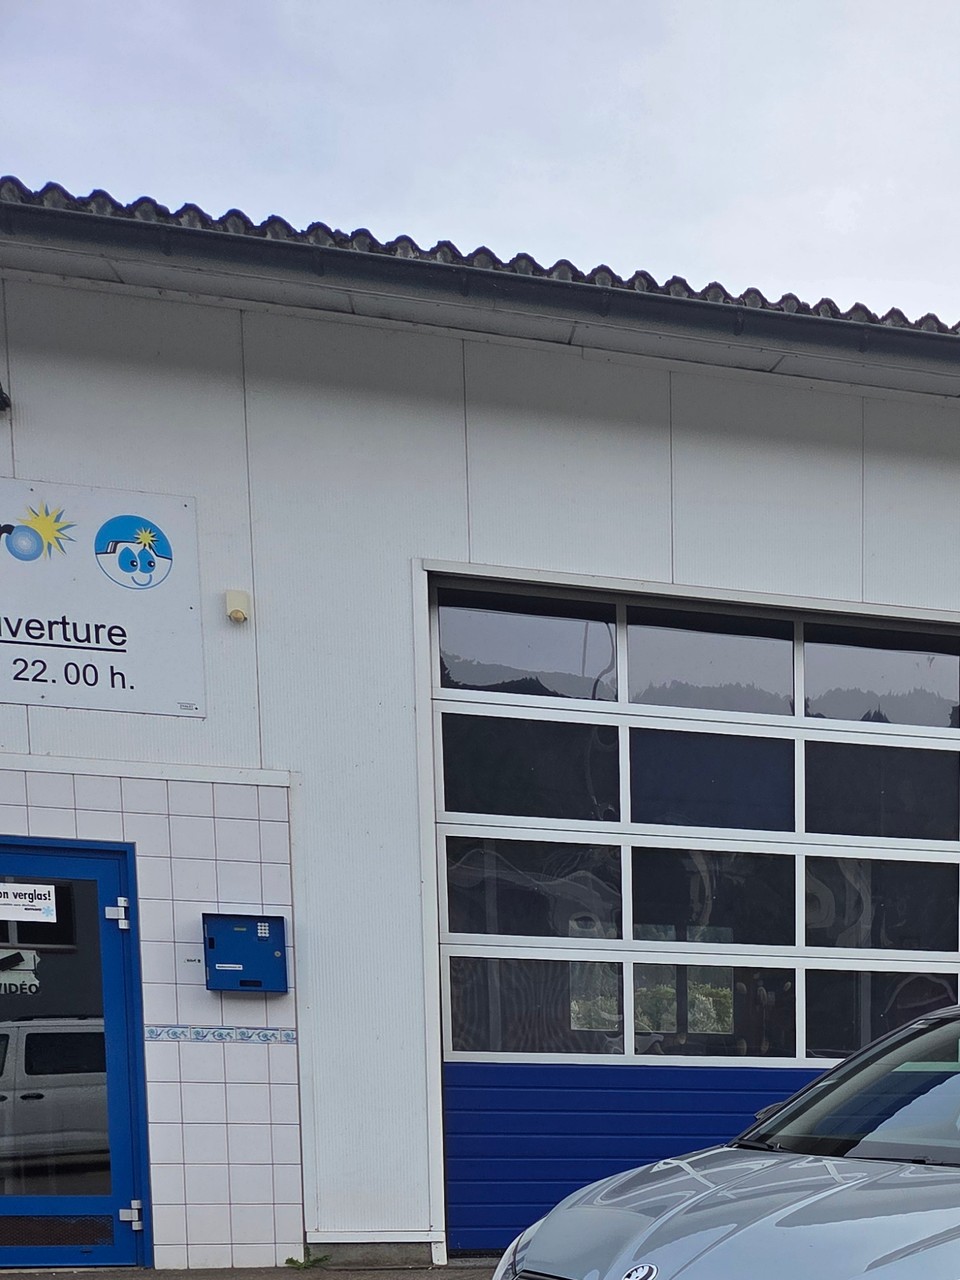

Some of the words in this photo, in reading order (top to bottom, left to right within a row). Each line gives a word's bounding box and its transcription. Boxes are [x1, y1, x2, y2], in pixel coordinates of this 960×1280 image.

[0, 615, 127, 646] verture
[109, 665, 135, 690] h.
[12, 889, 51, 903] verglas!
[0, 980, 38, 994] IDÉO
